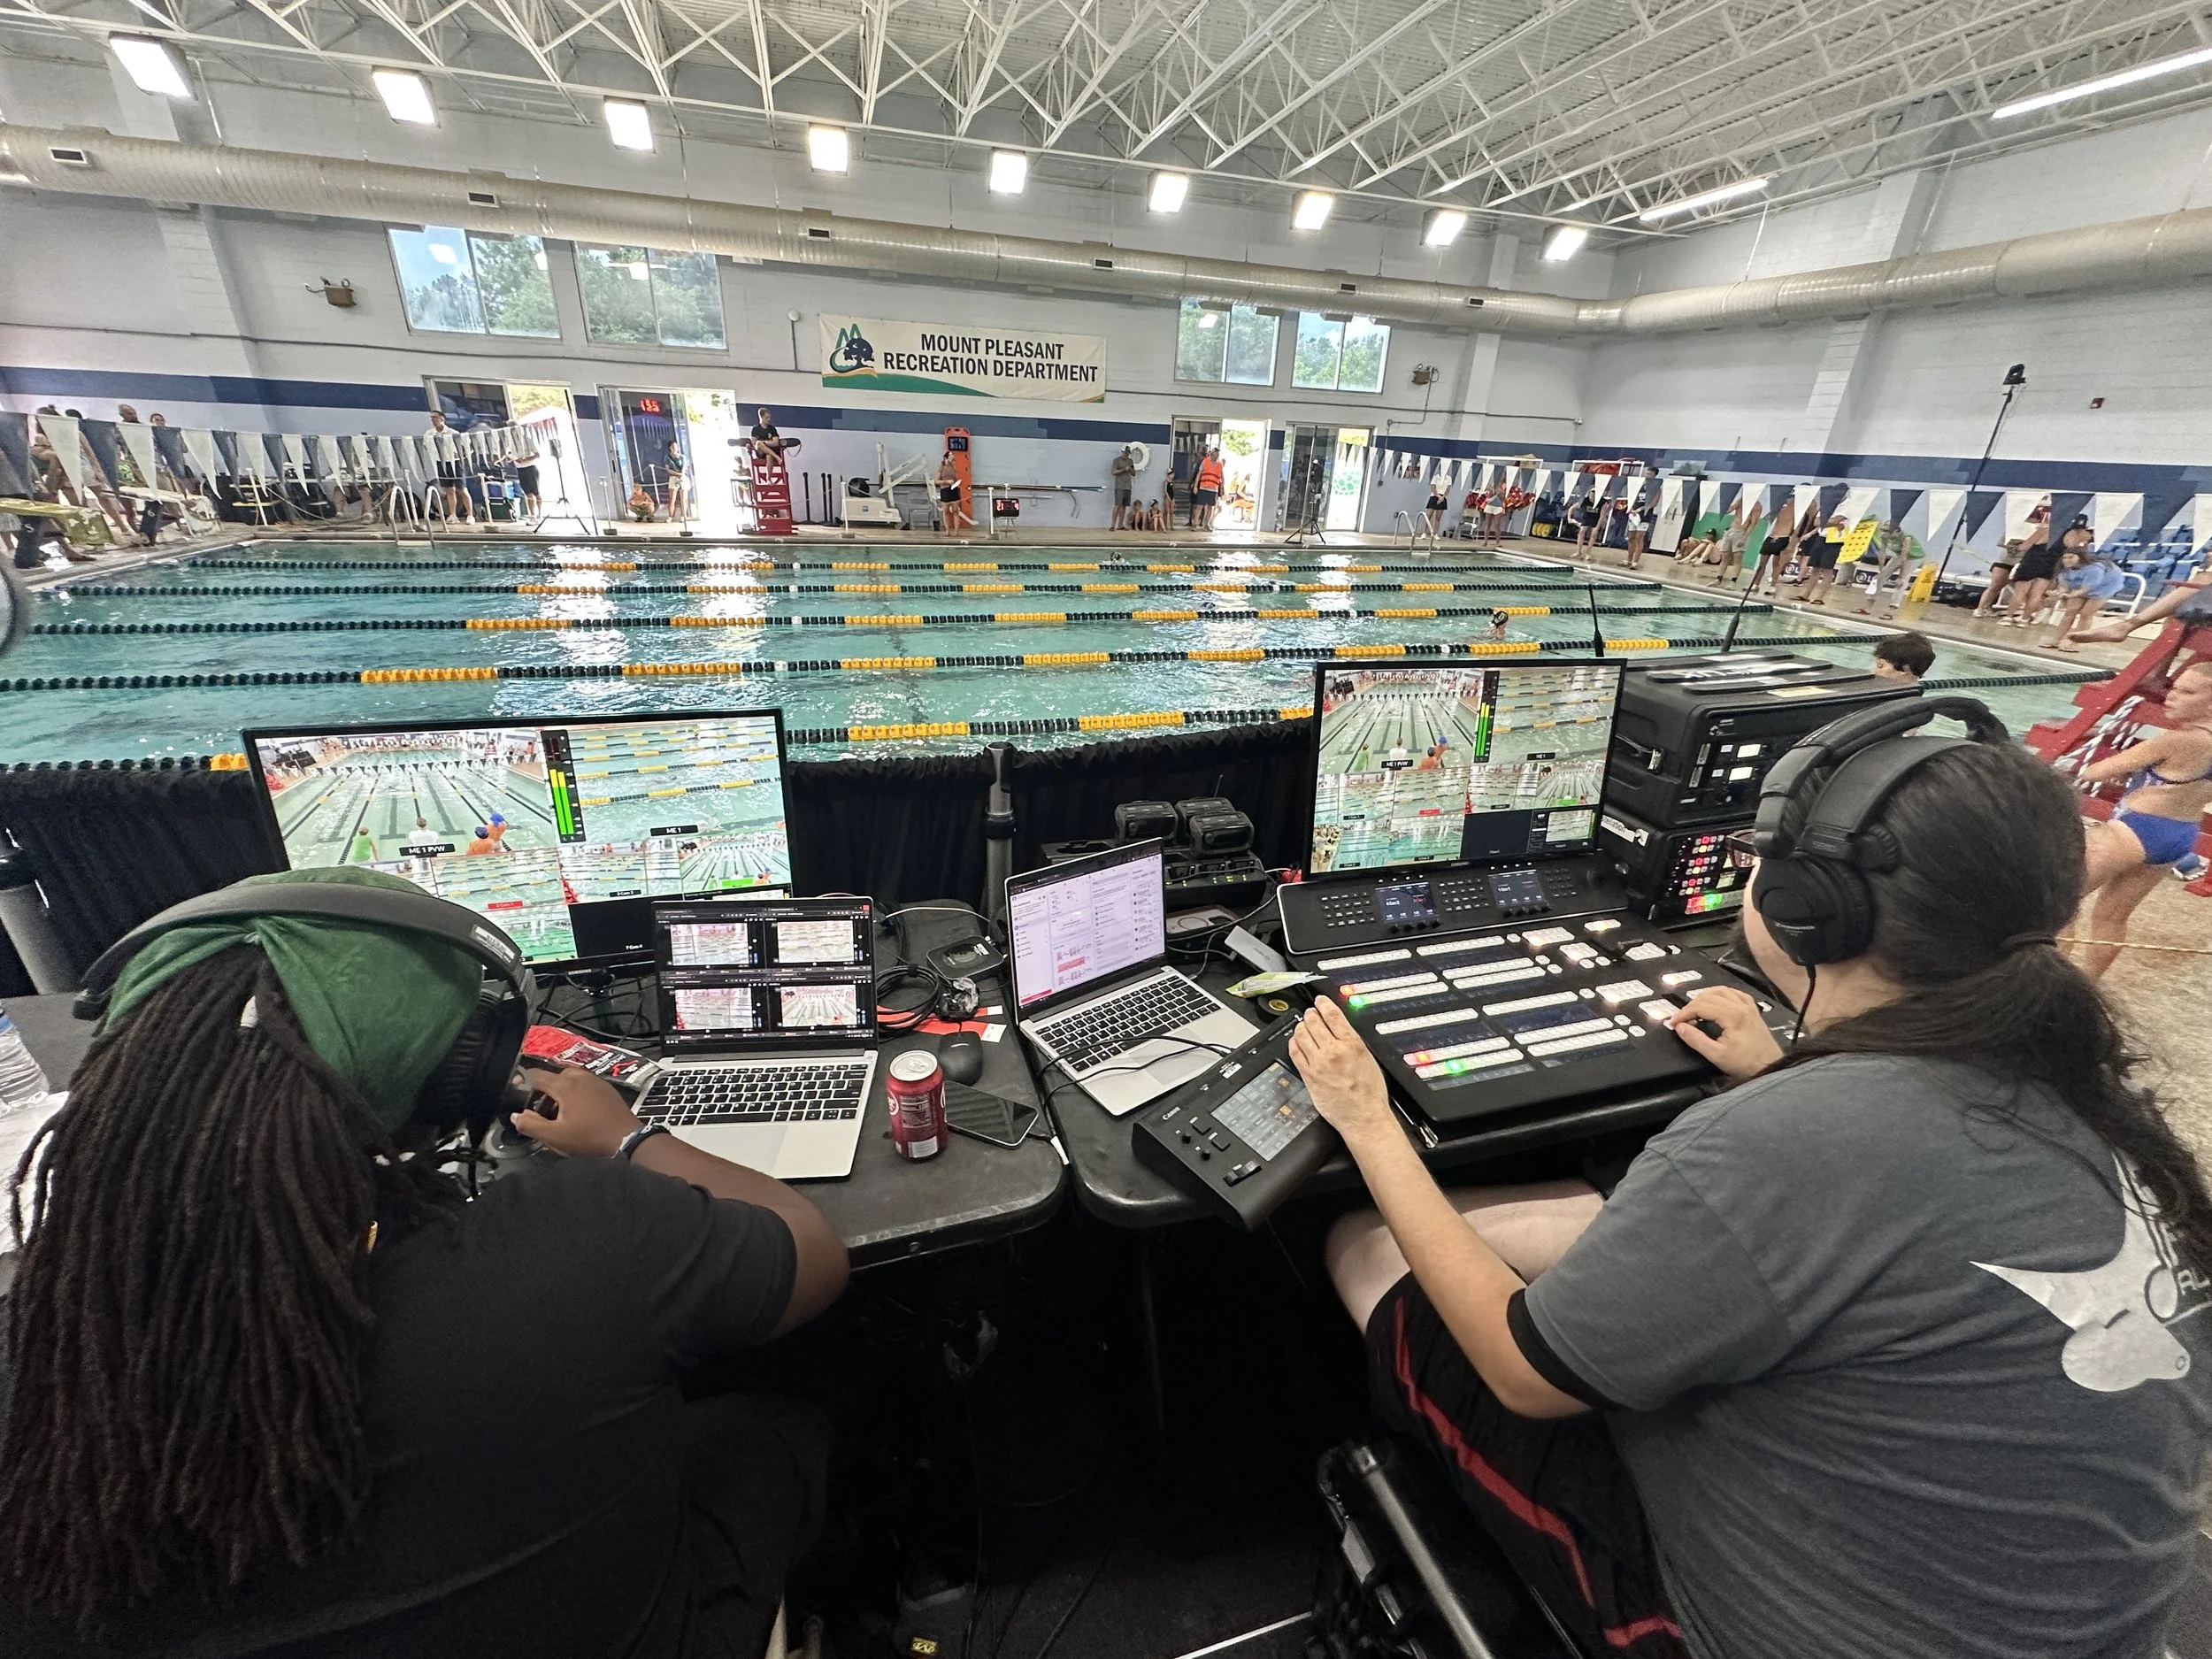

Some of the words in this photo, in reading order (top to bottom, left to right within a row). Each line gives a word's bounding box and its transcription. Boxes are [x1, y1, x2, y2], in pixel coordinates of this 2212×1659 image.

[921, 334, 980, 353] MOUNT
[986, 340, 1064, 359] PLEASANT
[884, 352, 987, 376] RECREATION
[994, 360, 1098, 382] DEPARTMENT
[24, 524, 35, 534] 5
[1162, 1106, 1181, 1120] Canon
